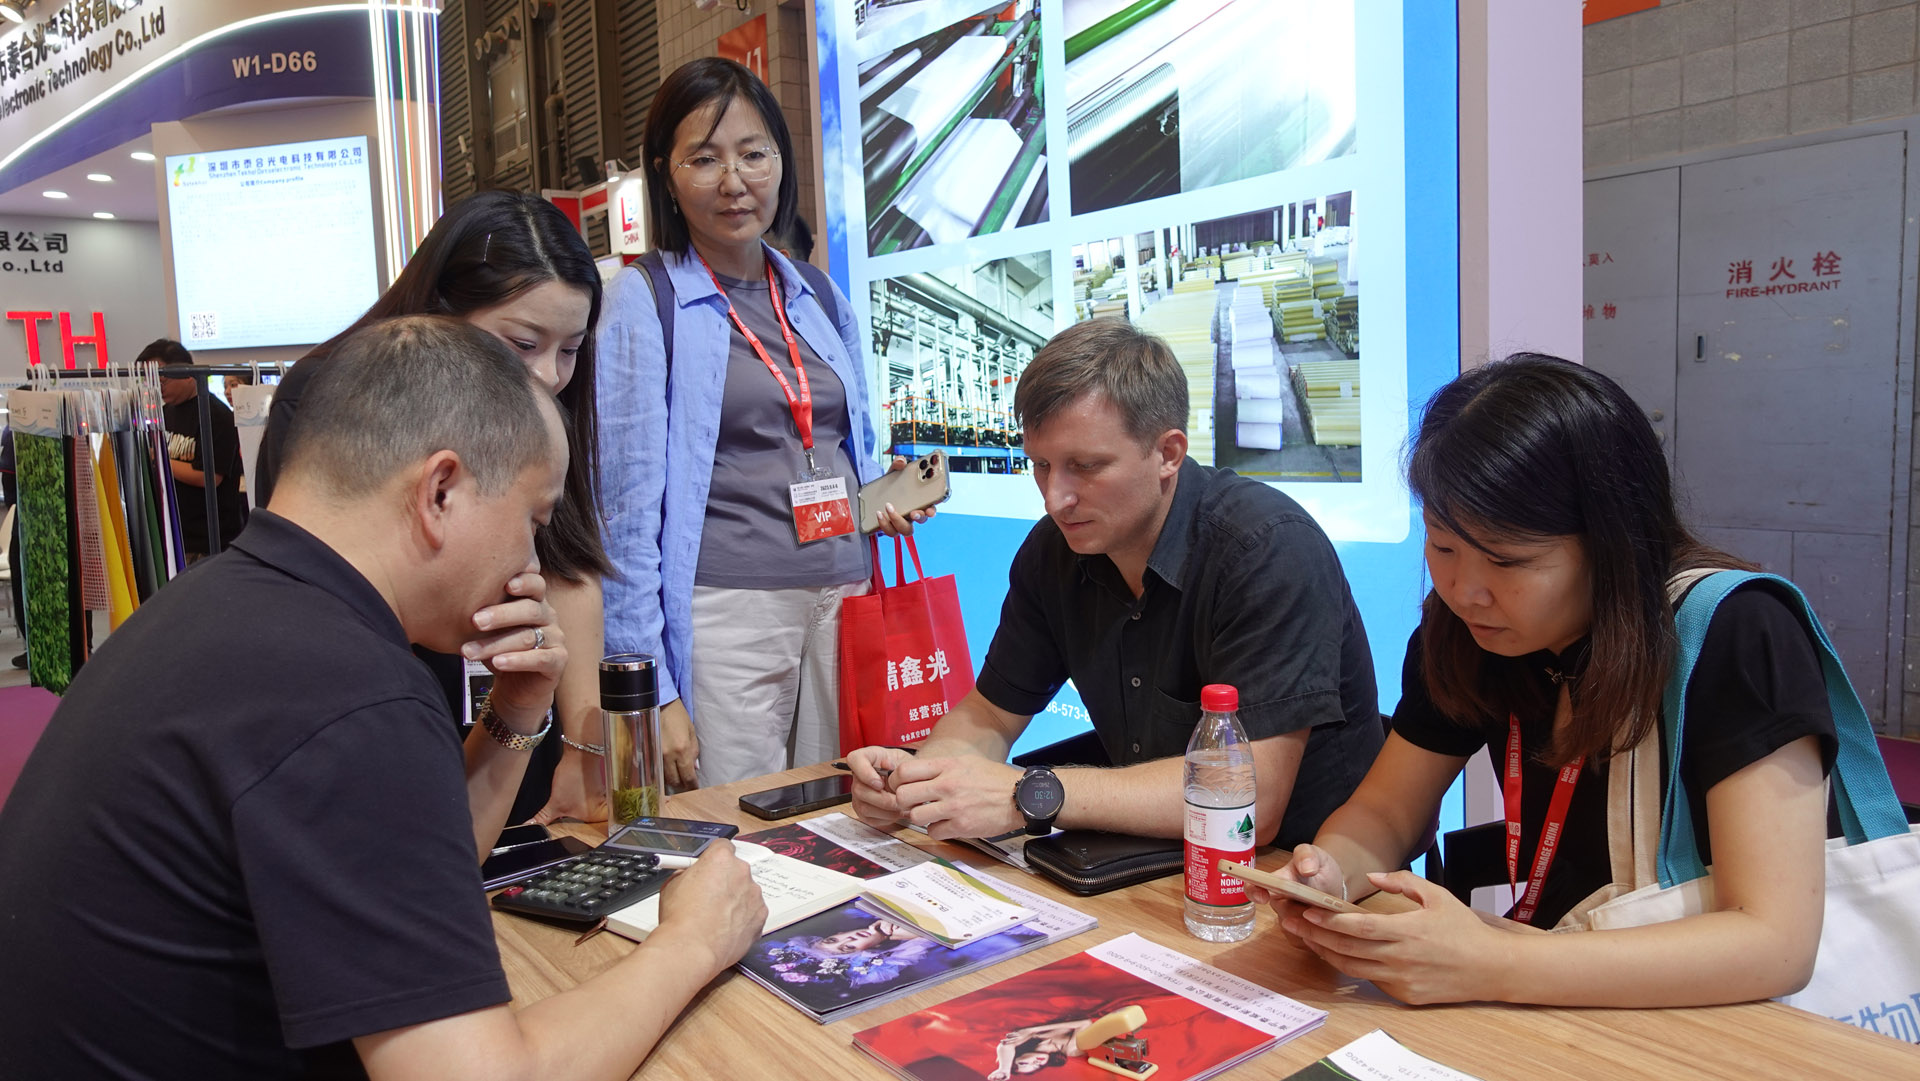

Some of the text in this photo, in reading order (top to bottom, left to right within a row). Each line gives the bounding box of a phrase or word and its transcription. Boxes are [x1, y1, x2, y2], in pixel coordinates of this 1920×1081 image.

[115, 6, 165, 56] Co.,Ltd
[231, 50, 317, 79] W1-D66
[0, 259, 64, 274] o.,Ltd
[1728, 250, 1842, 285] 消火栓
[1726, 279, 1842, 299] FIRE-HYDRANT
[6, 311, 109, 370] TH
[814, 511, 832, 523] VIP
[1509, 752, 1519, 778] CHINA
[1509, 839, 1518, 860] SIGN
[1525, 878, 1542, 905] DIGITAL
[1534, 846, 1553, 878] SIGNAGE
[1544, 821, 1560, 847] CHINA
